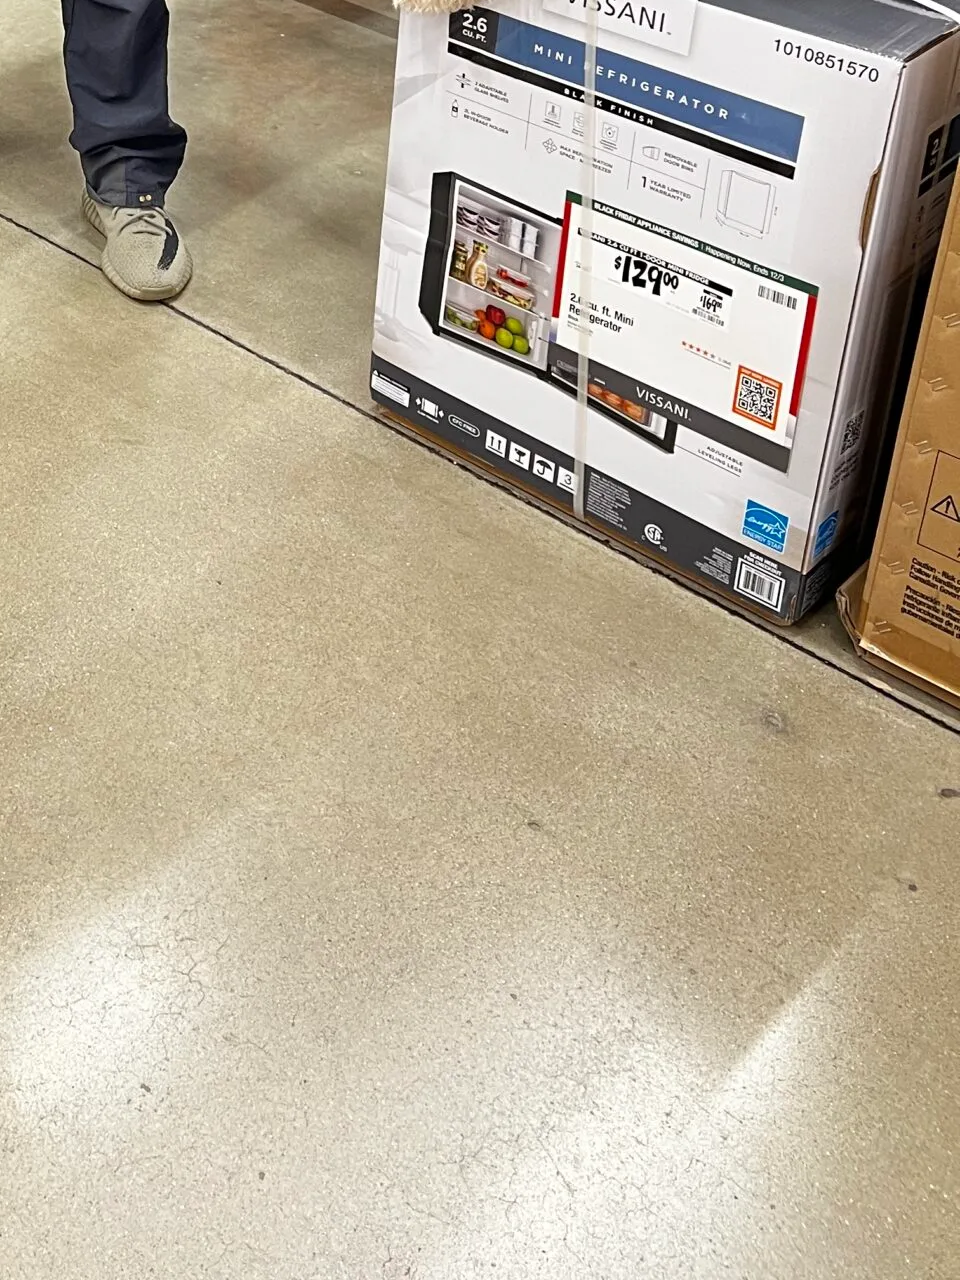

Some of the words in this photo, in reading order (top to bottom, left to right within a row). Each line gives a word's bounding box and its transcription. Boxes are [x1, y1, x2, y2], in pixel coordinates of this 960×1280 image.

[462, 12, 488, 33] 2.6
[462, 29, 475, 40] CU.
[476, 33, 487, 43] FT.
[773, 38, 880, 83] 1010851570
[534, 43, 573, 66] MINI
[589, 64, 730, 120] EFRIGERATOR
[563, 88, 603, 108] BLAK
[610, 104, 654, 126] FINISH
[642, 176, 647, 188] 1
[594, 202, 614, 216] BLACK
[614, 209, 636, 223] FRIDAY
[637, 219, 671, 237] APPLIANCE
[672, 233, 699, 248] SAVINGS
[705, 245, 737, 264] Happening
[753, 264, 769, 276] Ends
[770, 271, 785, 282] 12/3
[619, 243, 629, 252] CU
[629, 247, 638, 256] FT
[667, 261, 684, 273] MINI
[602, 306, 611, 317] ft.
[614, 311, 634, 327] Mini
[564, 474, 572, 485] 3
[743, 528, 766, 543] ENERGY
[766, 538, 783, 551] STAR
[910, 564, 932, 578] Follow
[912, 557, 936, 573] Caution
[941, 570, 956, 582] Risk
